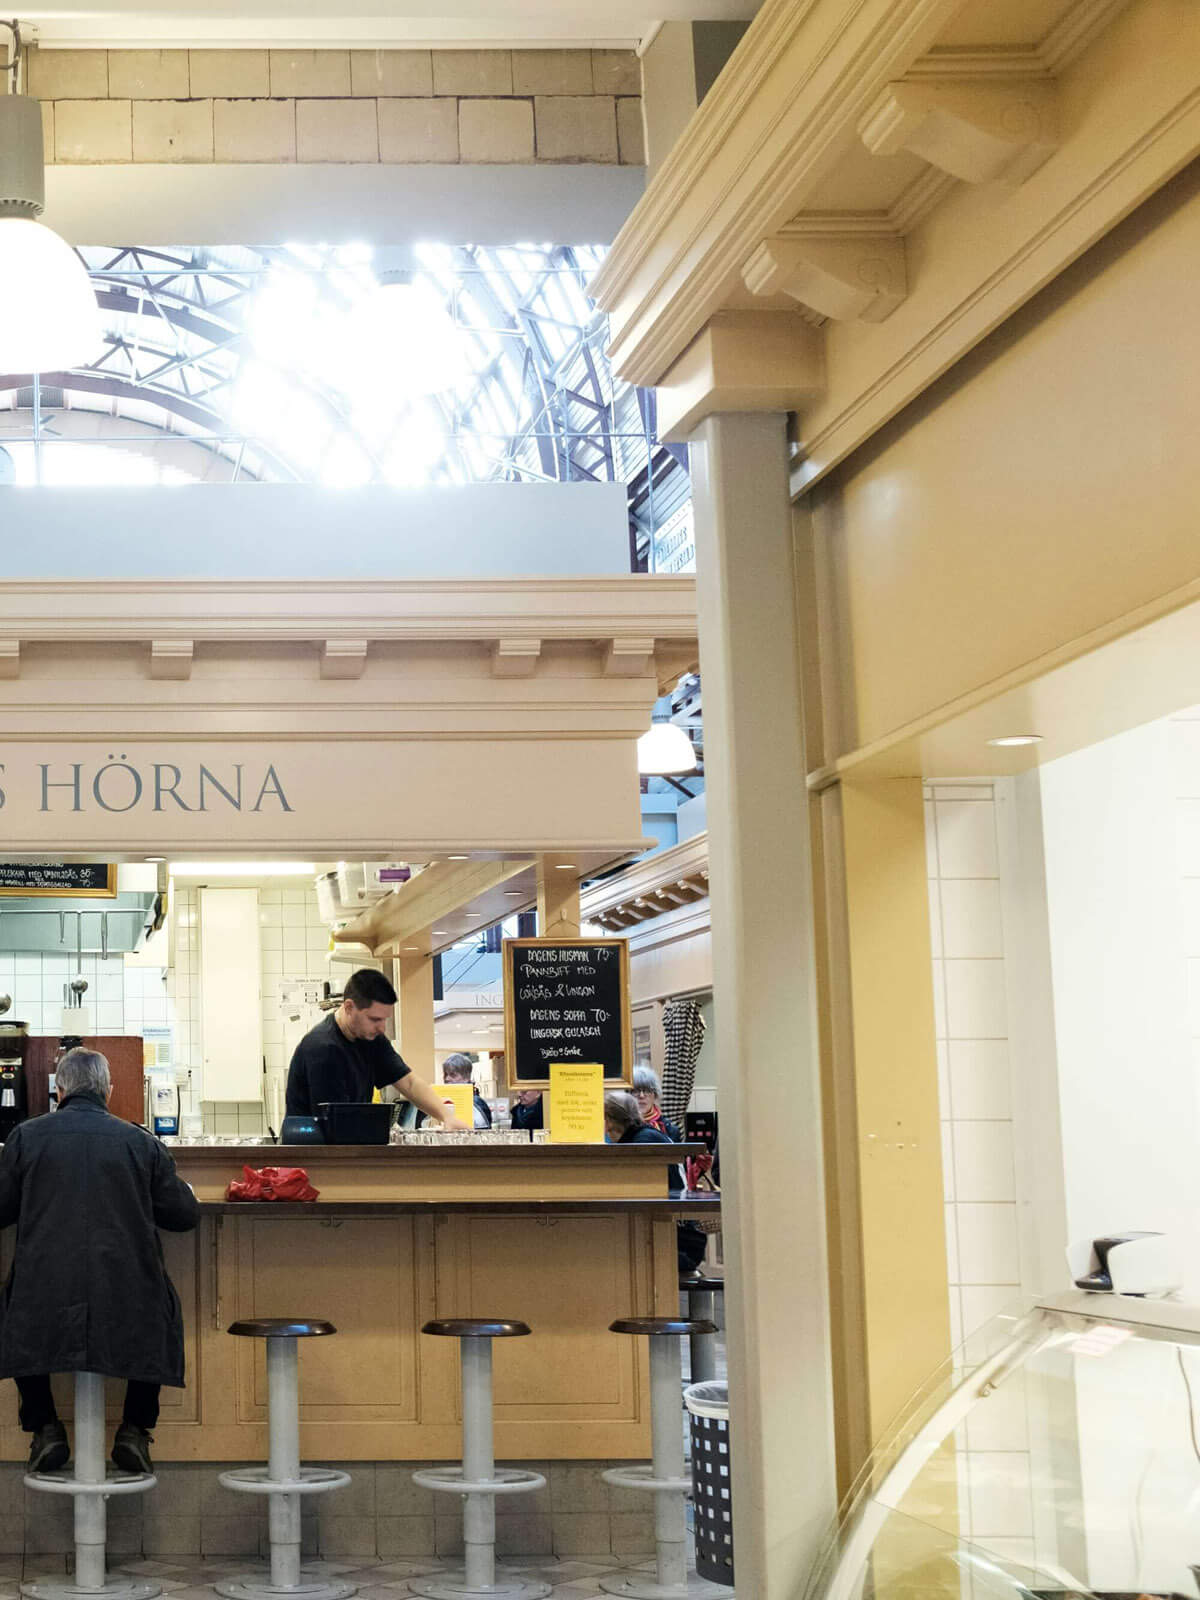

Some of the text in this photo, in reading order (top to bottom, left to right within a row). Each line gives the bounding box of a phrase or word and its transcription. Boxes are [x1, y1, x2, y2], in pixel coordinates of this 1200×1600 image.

[36, 753, 297, 813] HÖRNA
[527, 949, 557, 962] DAGENS
[520, 963, 596, 978] PANNBIFF MED
[530, 1009, 560, 1021] DAGENS
[563, 1010, 586, 1021] SOPPA
